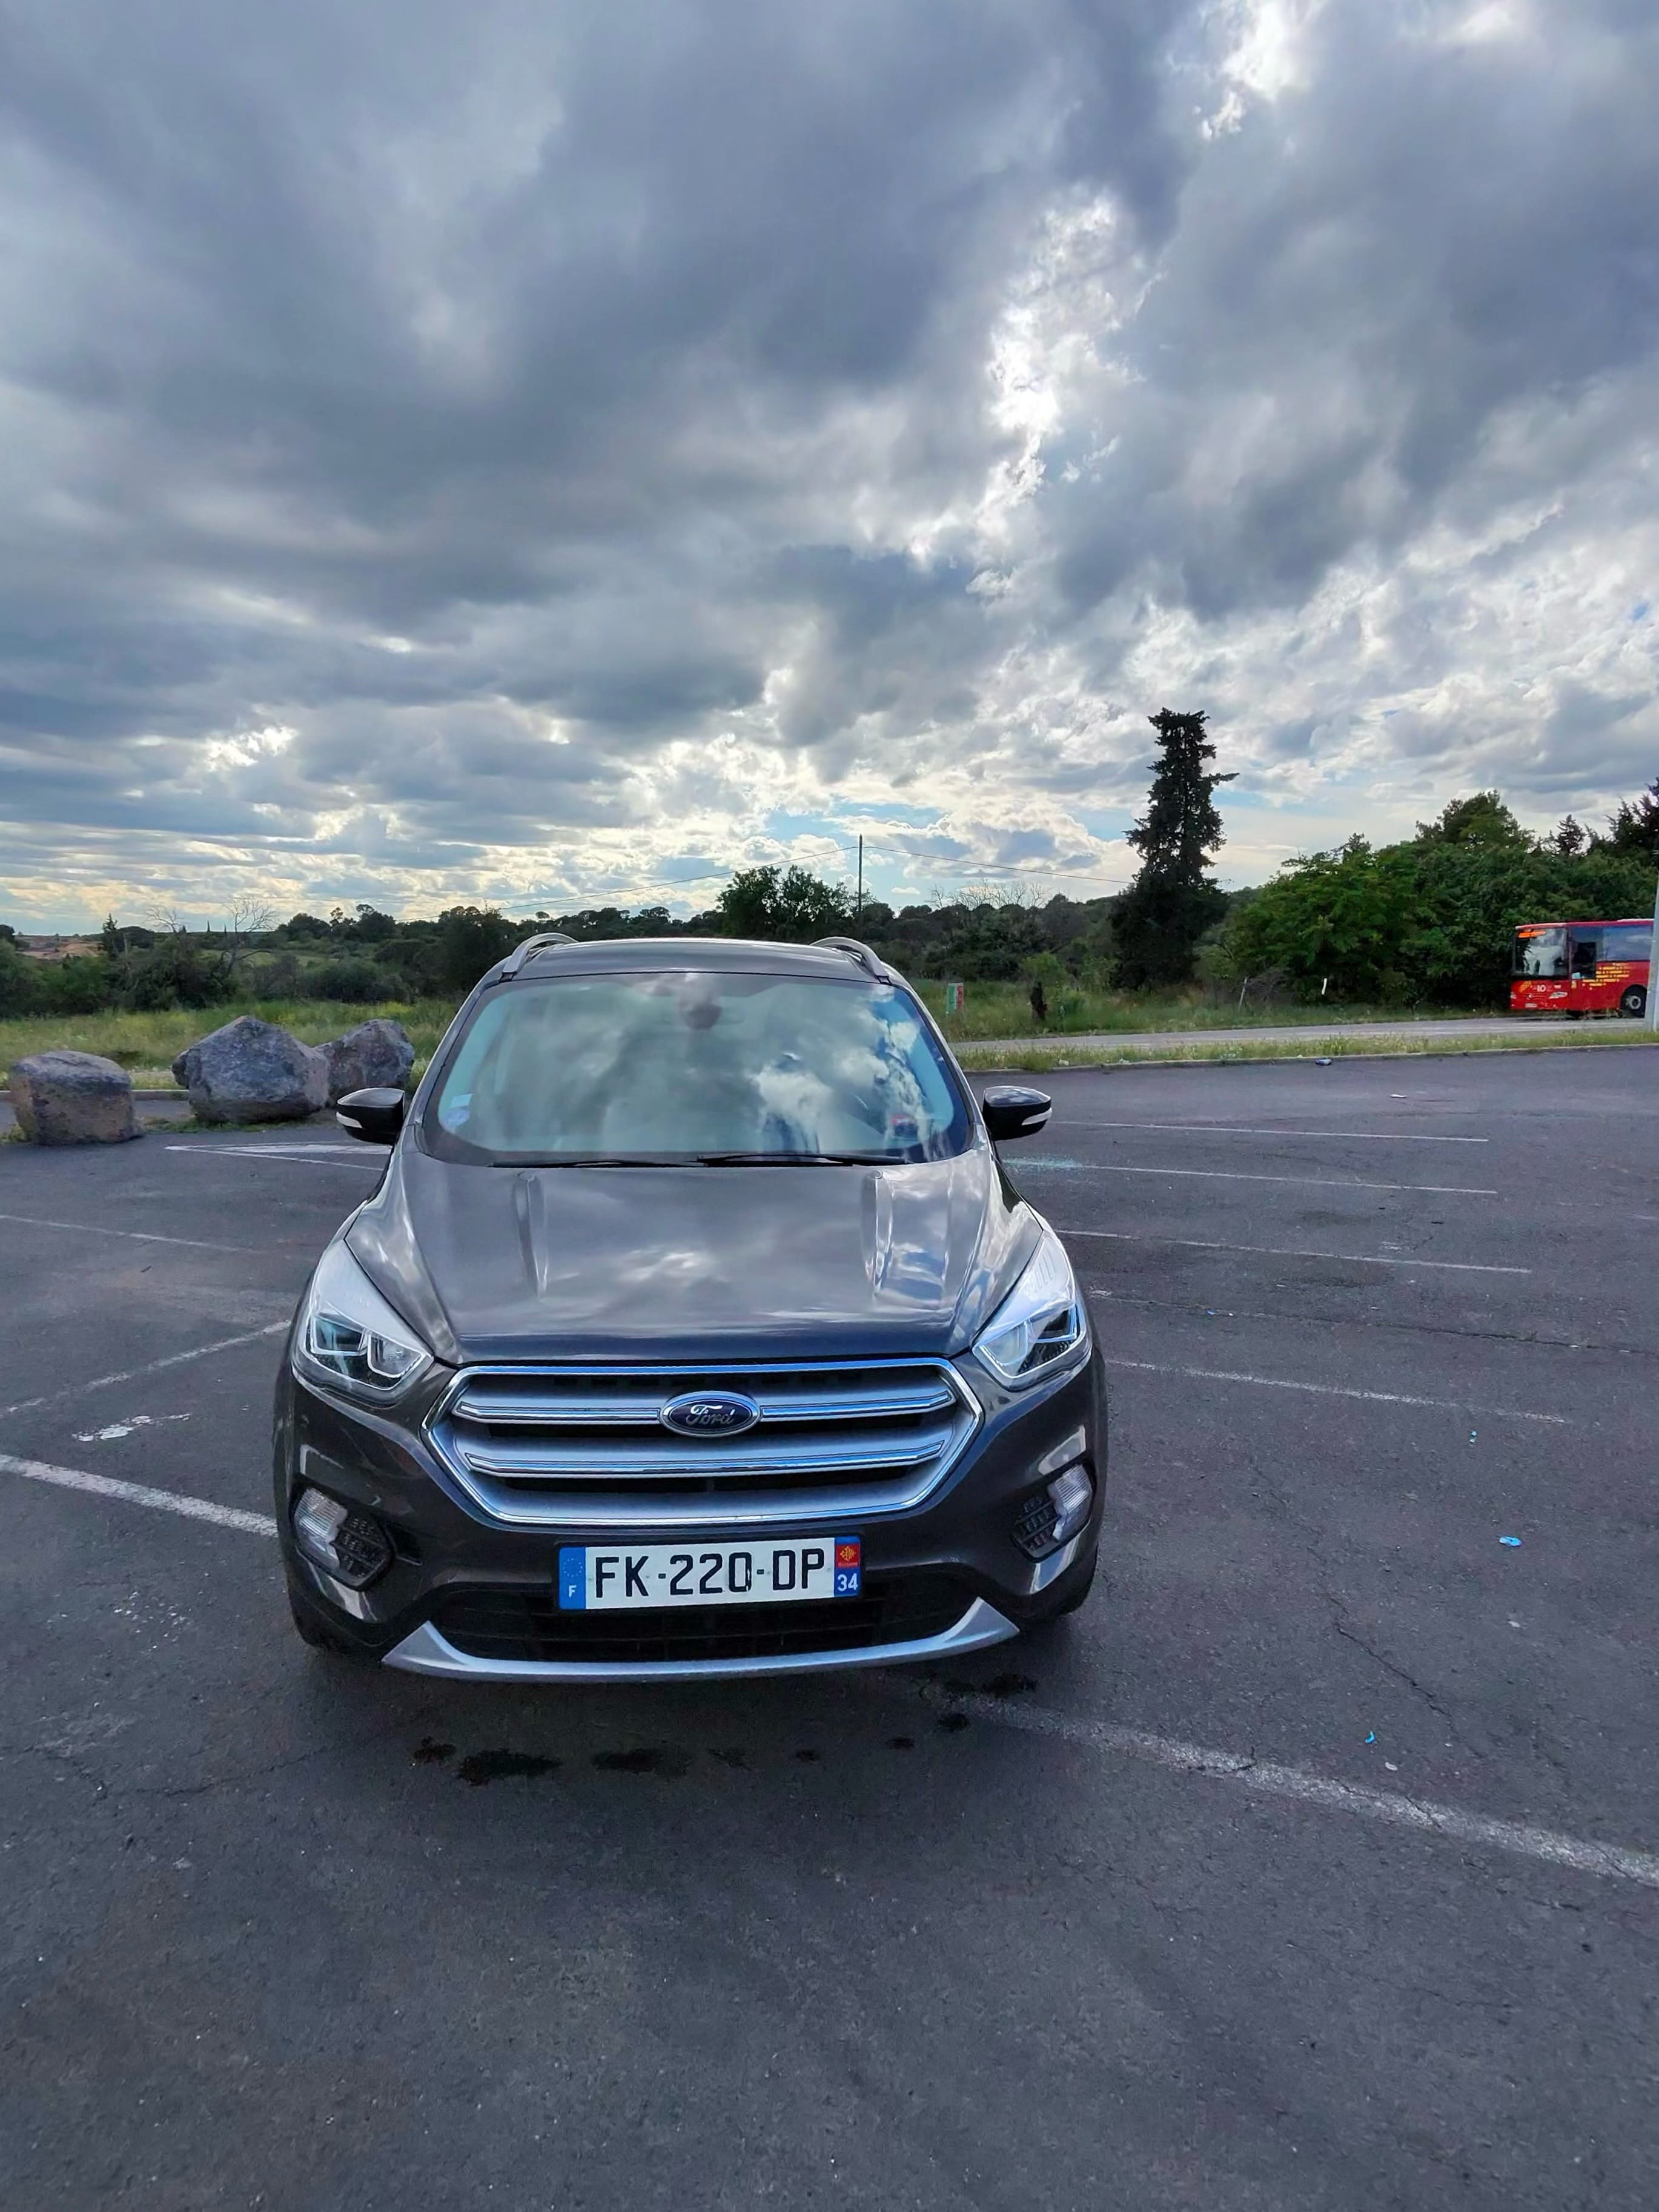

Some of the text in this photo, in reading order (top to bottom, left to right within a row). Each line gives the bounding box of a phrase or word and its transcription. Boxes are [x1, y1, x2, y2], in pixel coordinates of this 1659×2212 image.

[686, 1404, 736, 1425] Ford
[595, 1548, 824, 1598] FK-220-DP
[837, 1573, 858, 1591] 34
[569, 1585, 577, 1597] F
